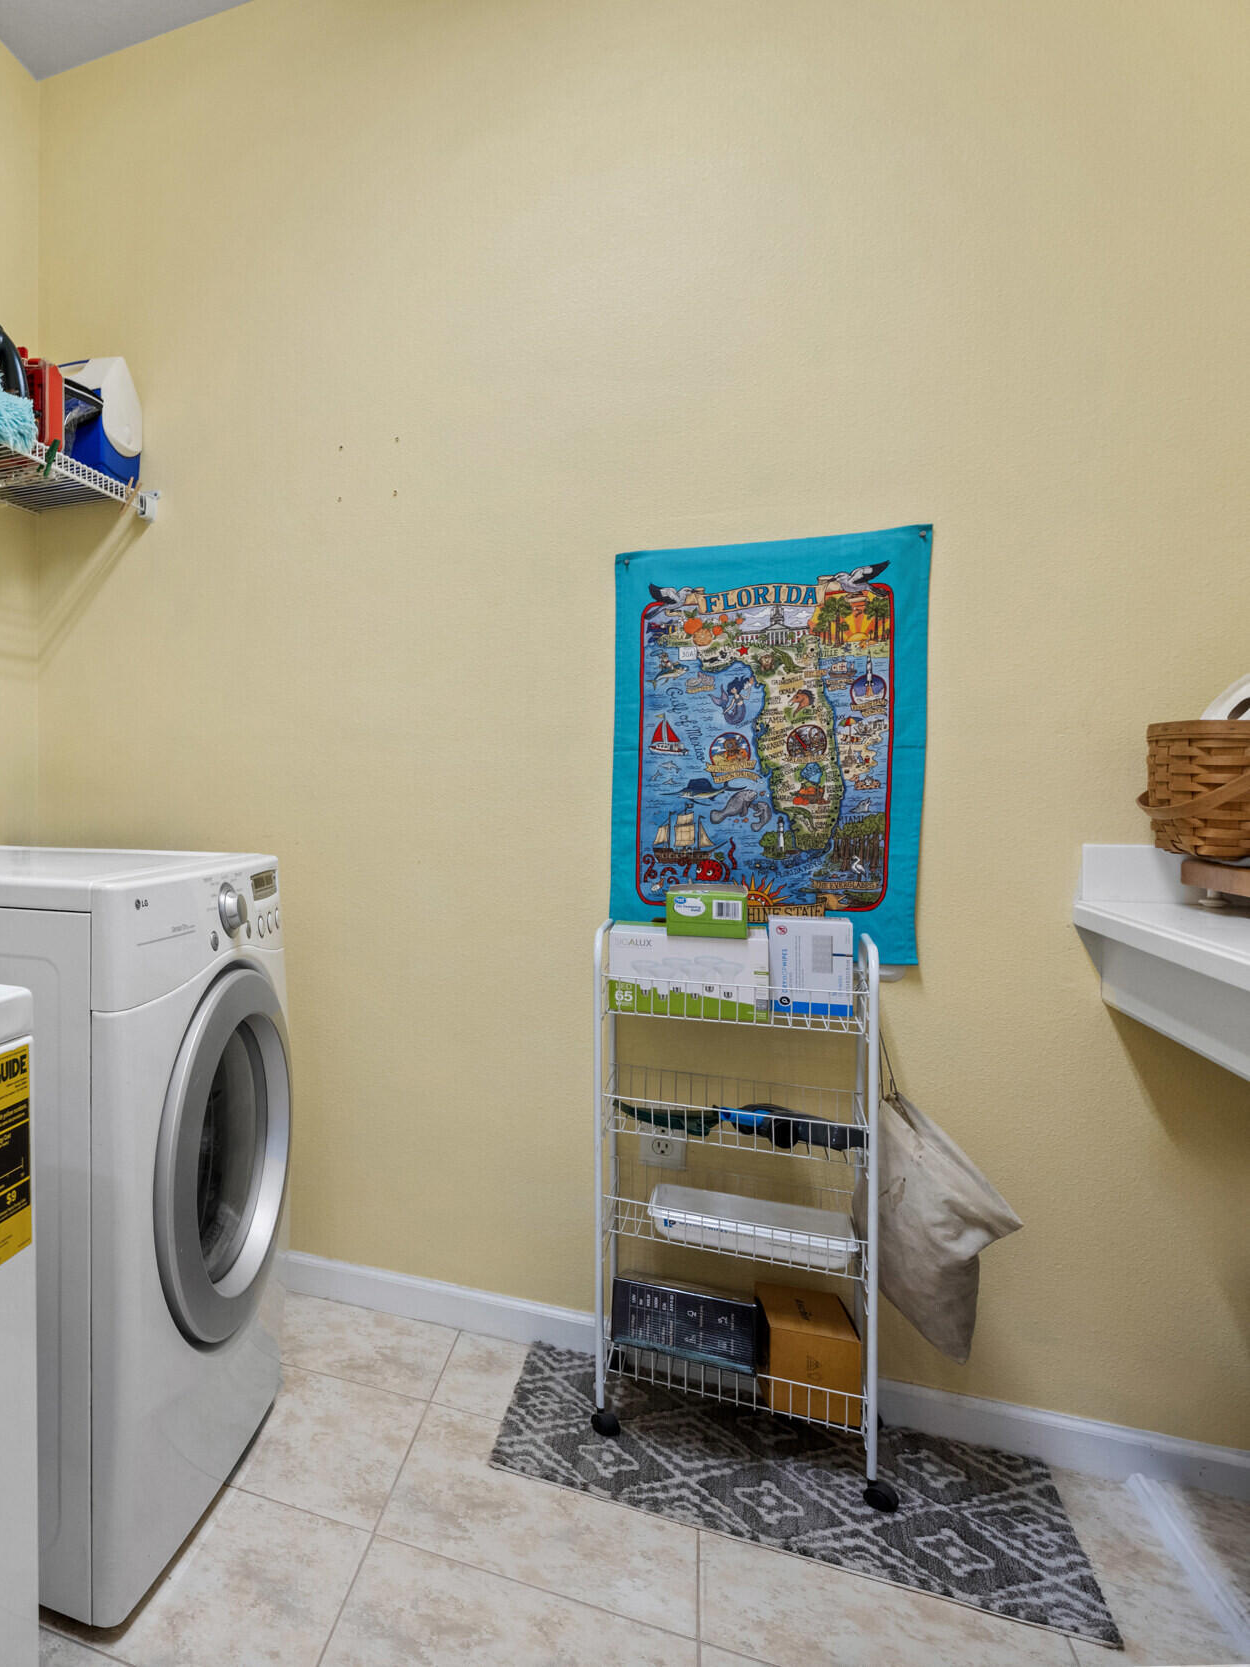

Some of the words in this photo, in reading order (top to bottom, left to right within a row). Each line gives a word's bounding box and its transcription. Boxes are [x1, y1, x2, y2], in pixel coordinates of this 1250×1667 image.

[702, 584, 819, 614] FLORIDA
[141, 899, 149, 908] LG
[784, 904, 823, 918] STATE
[615, 990, 633, 1002] 65
